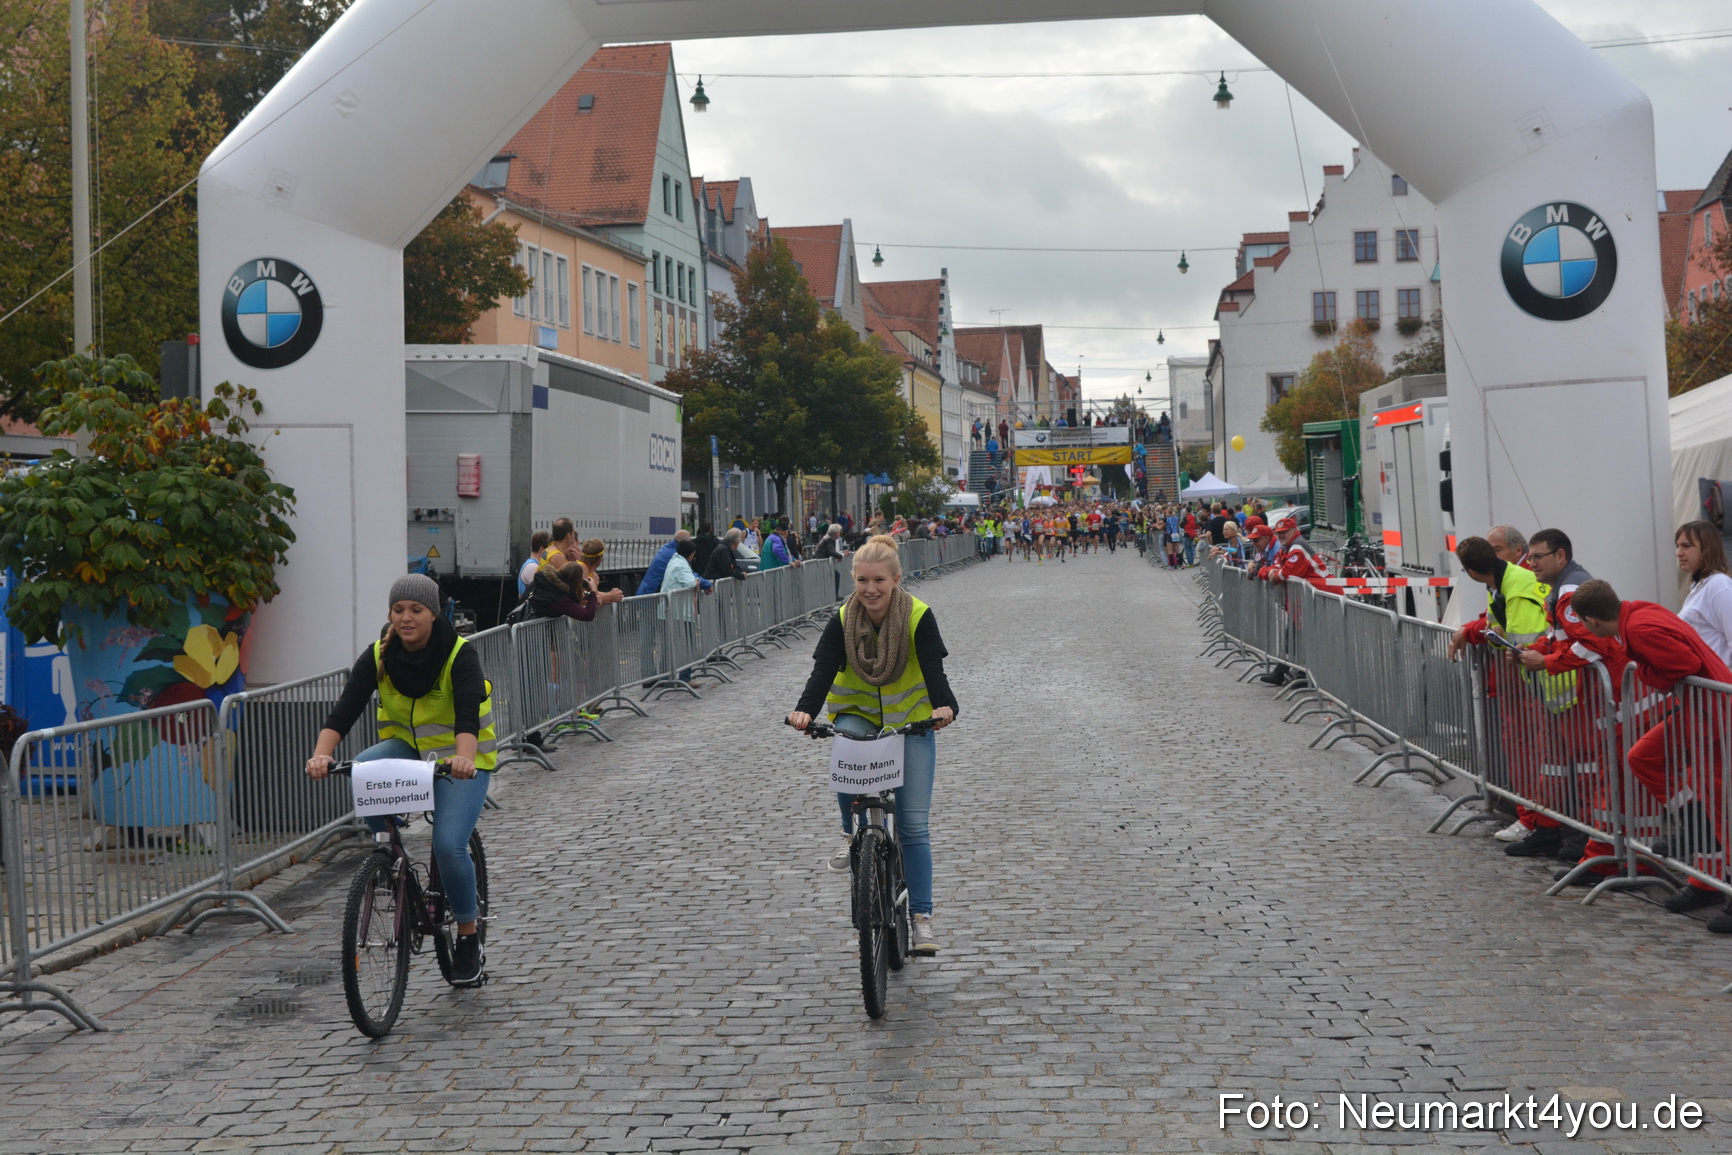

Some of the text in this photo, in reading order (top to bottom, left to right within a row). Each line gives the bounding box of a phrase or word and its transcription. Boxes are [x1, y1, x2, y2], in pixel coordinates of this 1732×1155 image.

[1509, 204, 1607, 246] BMW
[228, 260, 315, 297] BMW
[649, 433, 676, 473] BOCK
[1053, 450, 1093, 461] START
[837, 759, 895, 771] Erster Mann
[366, 778, 418, 790] Erste Frau
[831, 769, 901, 786] Schnupperlauf
[357, 791, 430, 806] Schnupperlauf
